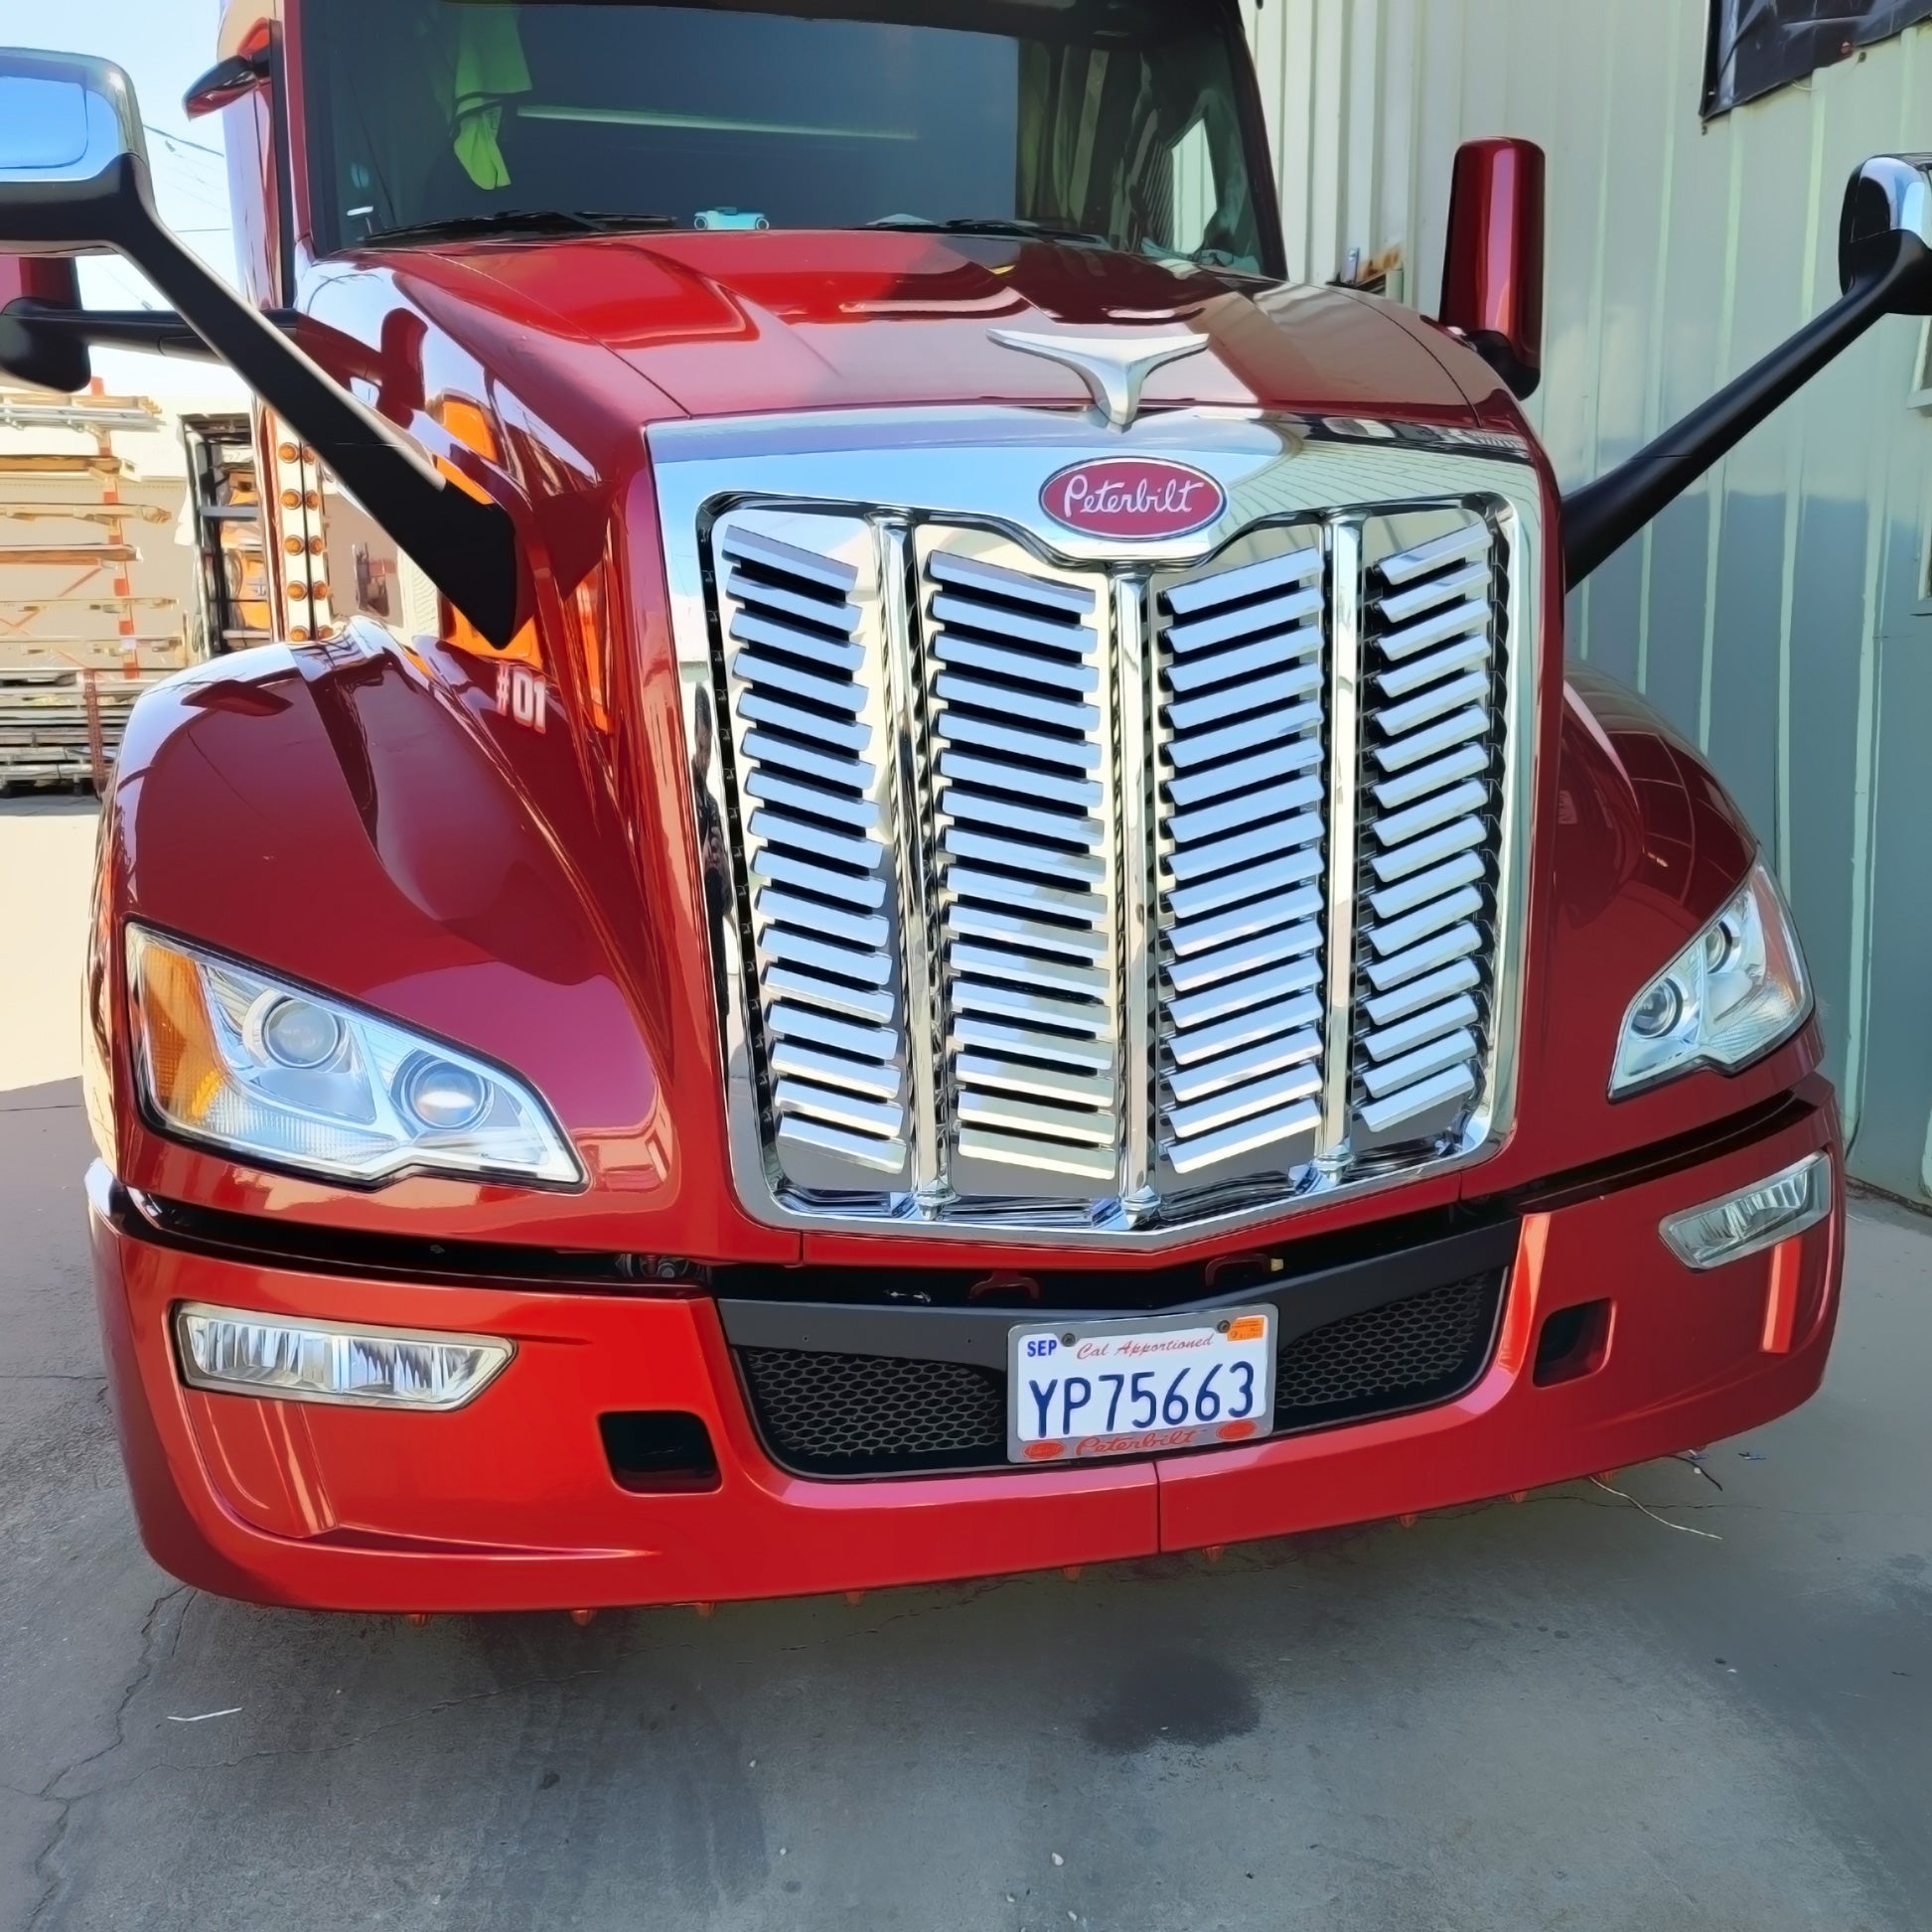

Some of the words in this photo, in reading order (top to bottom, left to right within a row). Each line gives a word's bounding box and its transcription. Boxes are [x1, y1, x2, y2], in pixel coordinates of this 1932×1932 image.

[1064, 474, 1205, 519] Peterbilt
[1027, 1339, 1058, 1358] SEP
[1076, 1342, 1110, 1360] Cal
[1114, 1332, 1215, 1357] Apportioned
[1028, 1360, 1255, 1439] YP75663
[1075, 1428, 1206, 1456] Peterbilt
